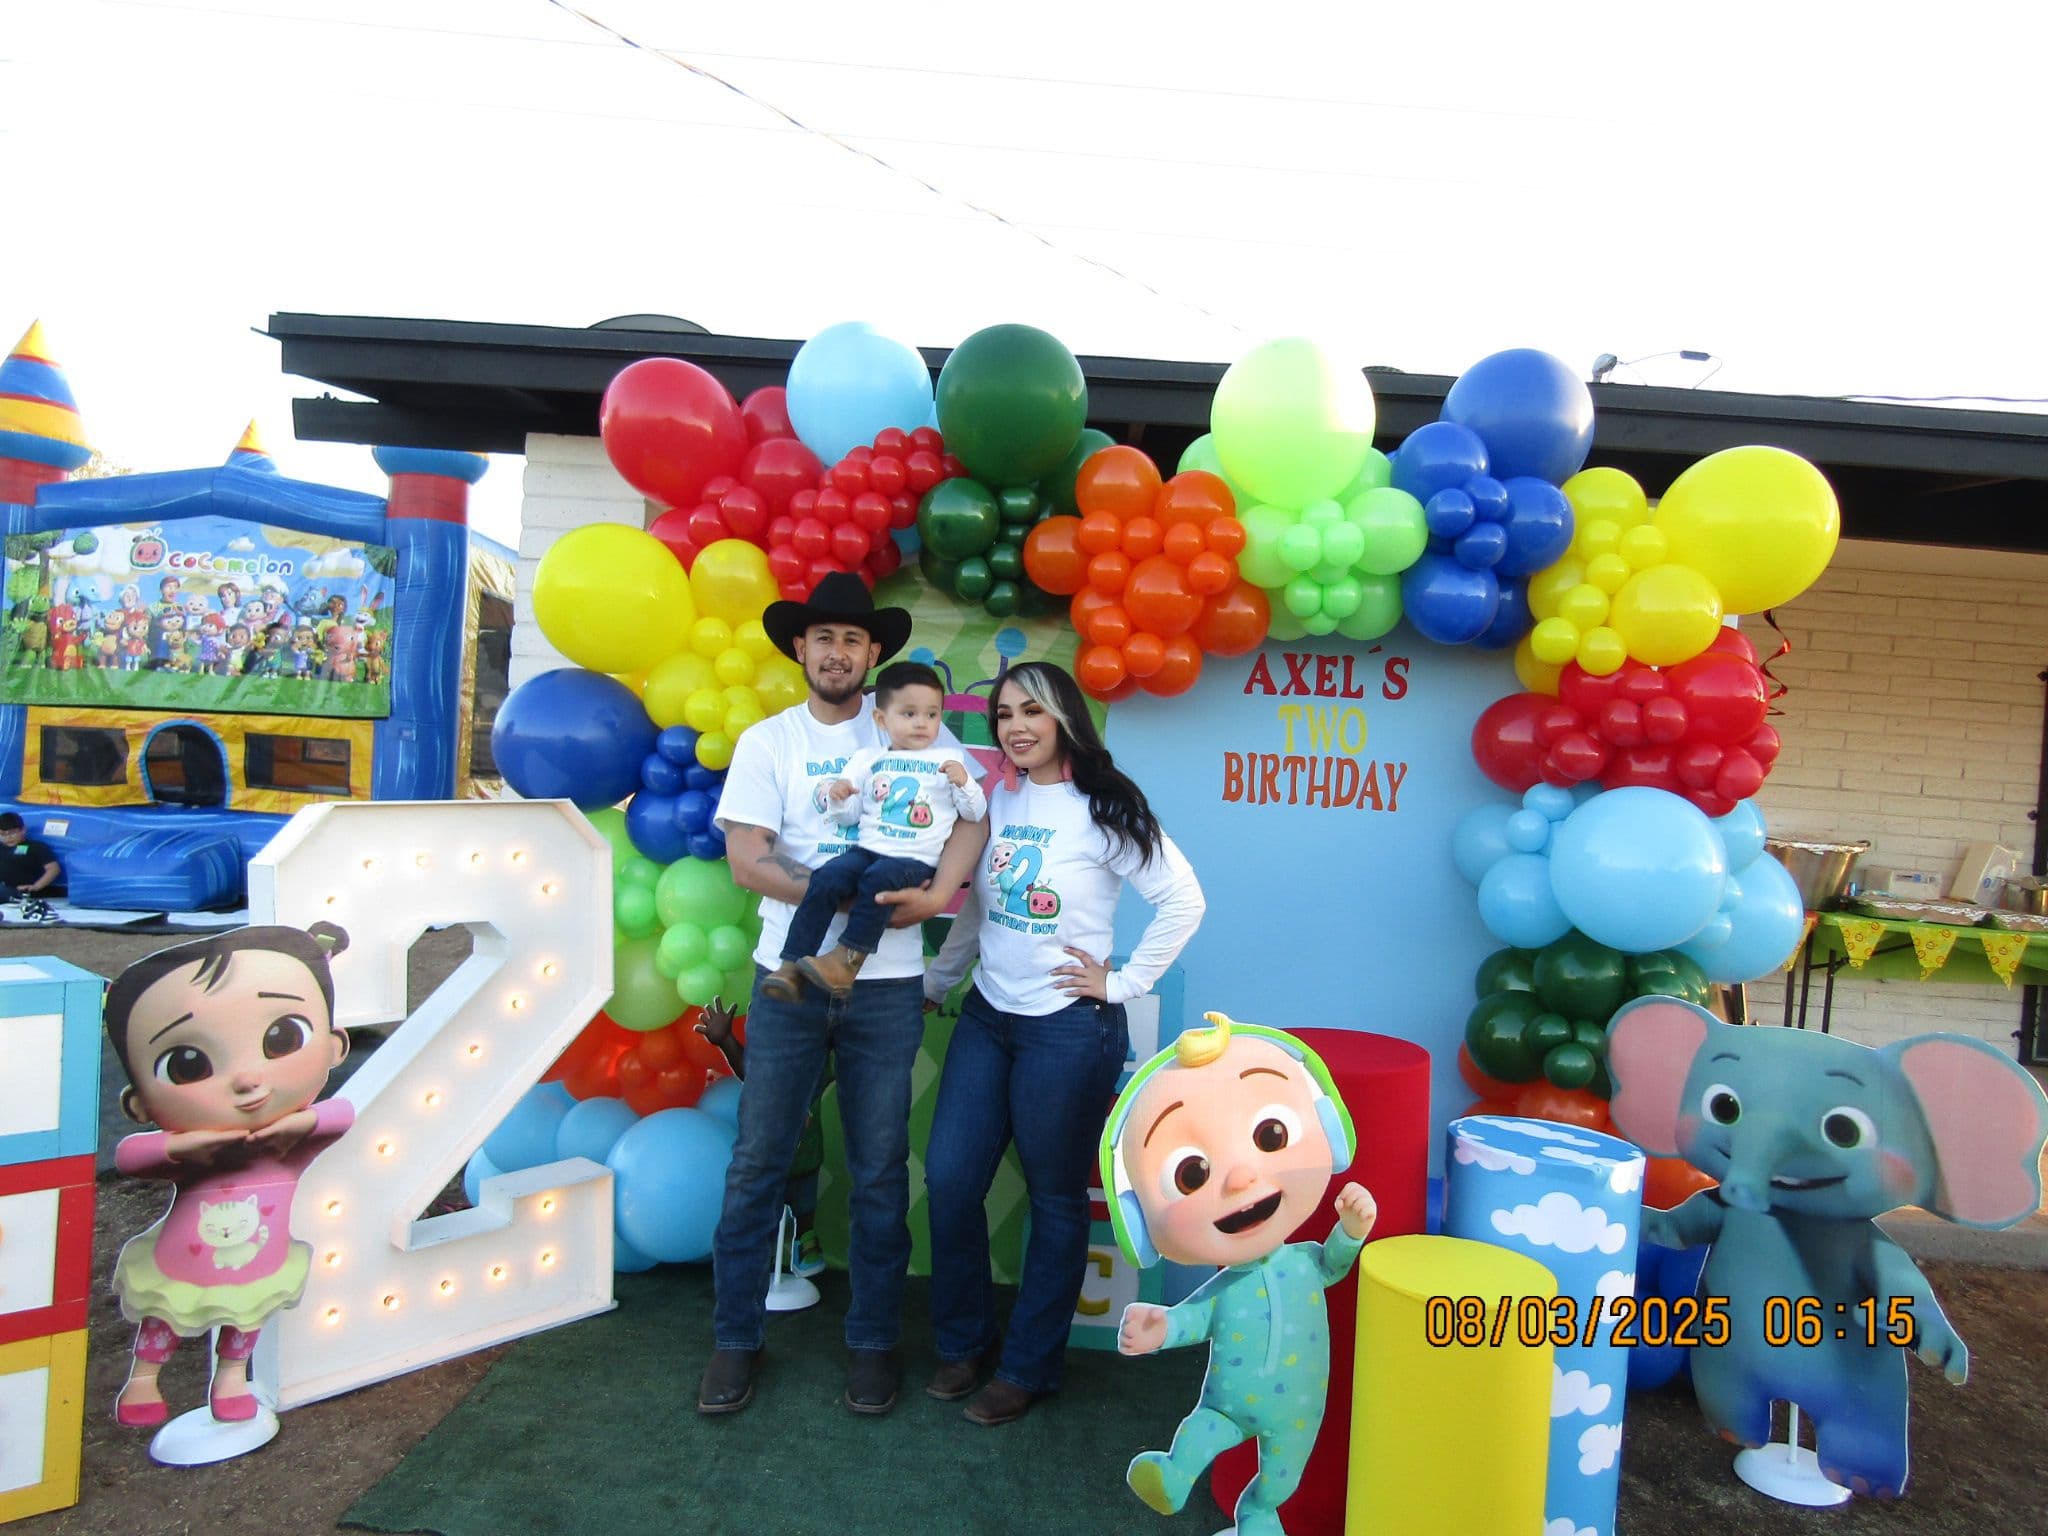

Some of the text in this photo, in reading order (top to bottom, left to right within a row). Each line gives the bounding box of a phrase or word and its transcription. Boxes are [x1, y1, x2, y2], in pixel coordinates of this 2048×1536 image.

[1277, 703, 1368, 755] TWO
[881, 775, 920, 827] 2
[1221, 751, 1408, 812] BIRTHDAY
[999, 824, 1057, 844] MOMMY
[1004, 844, 1043, 919] 2
[988, 909, 1058, 935] BIRTHDAY BOY
[248, 797, 618, 1413] 2
